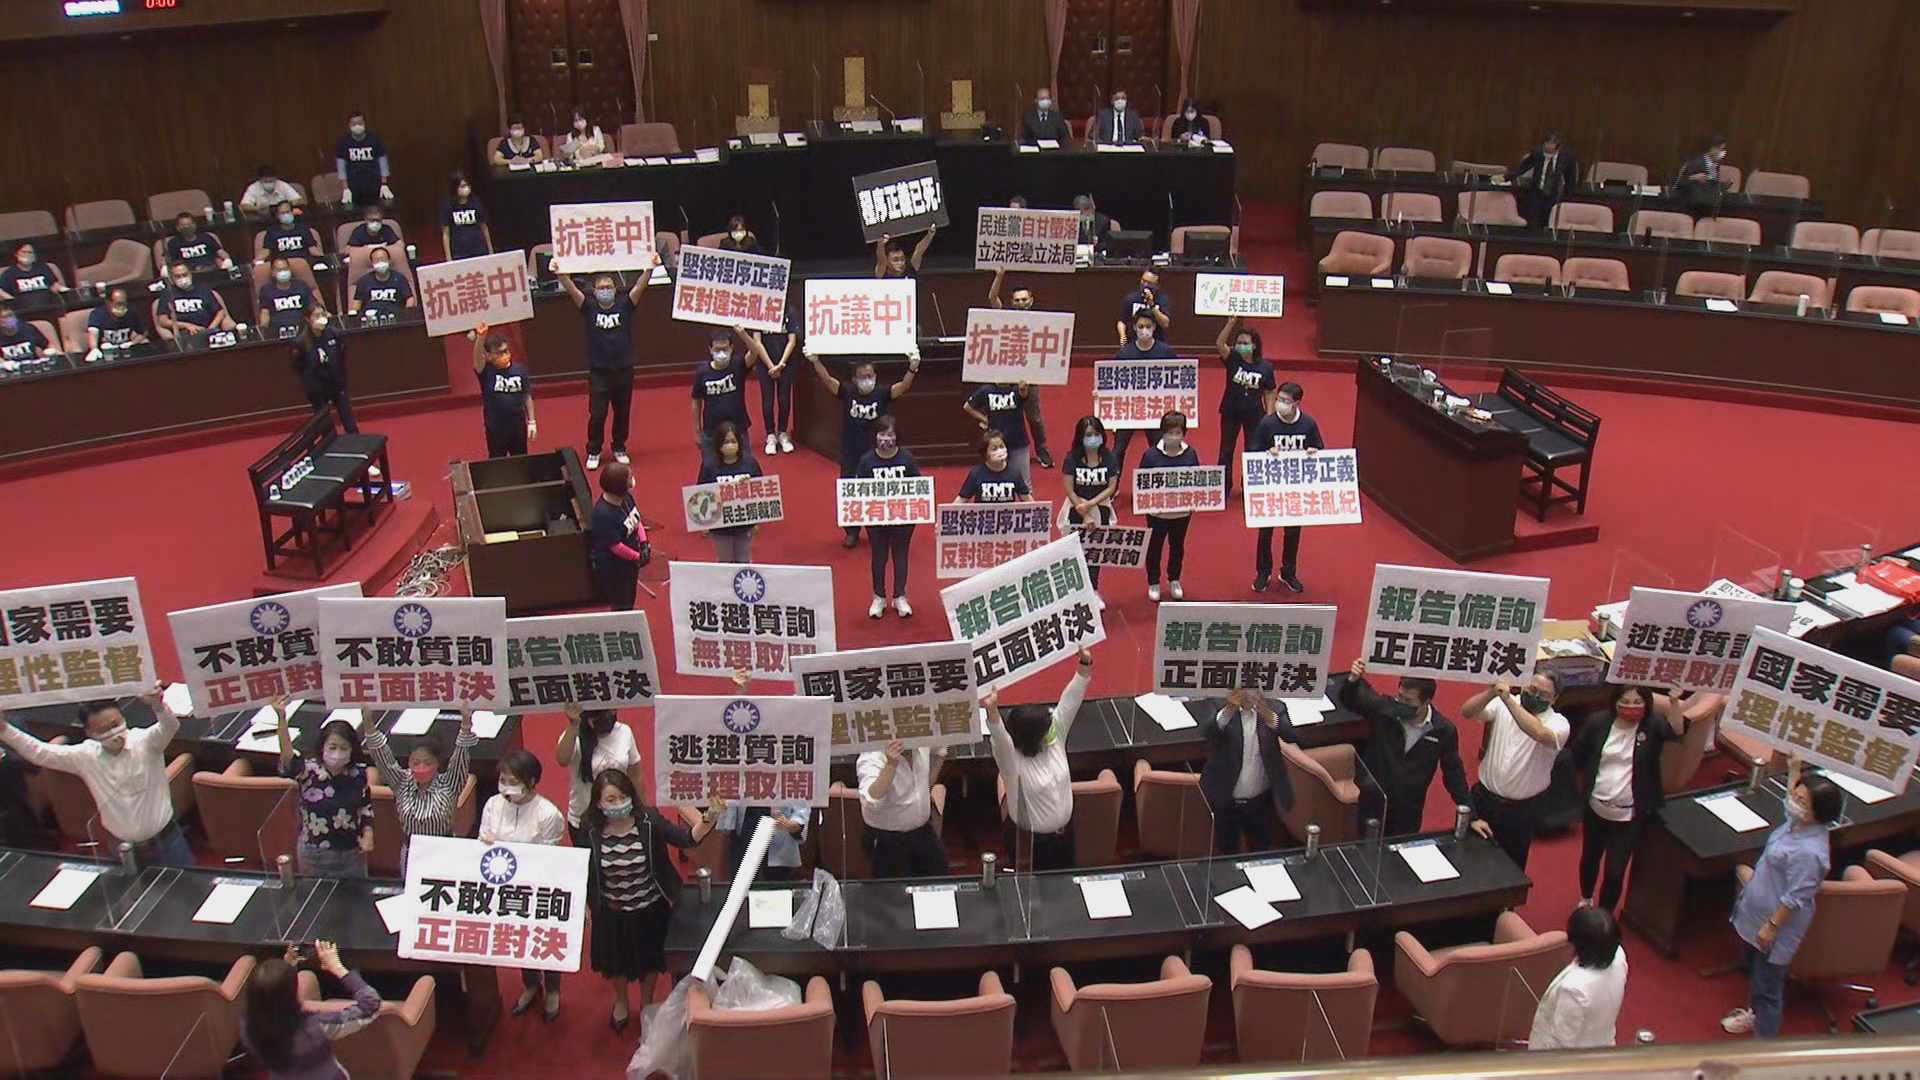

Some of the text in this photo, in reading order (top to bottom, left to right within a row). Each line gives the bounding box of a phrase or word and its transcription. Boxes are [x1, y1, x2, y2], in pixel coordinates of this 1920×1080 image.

[555, 215, 652, 257] 抗議中!
[977, 241, 1076, 266] 立法院變立法局
[680, 252, 787, 291] 堅持程序正義
[424, 265, 528, 320] 抗議中!
[677, 284, 783, 323] 反對違法亂紀
[809, 294, 912, 336] 抗議中!
[967, 323, 1071, 368] 抗議中!
[1097, 365, 1196, 390] 堅持程序正義
[1100, 395, 1196, 420] 反對違法亂紀
[1274, 434, 1306, 449] KMT
[872, 466, 906, 479] KMT
[1076, 467, 1107, 482] KMT
[1137, 470, 1222, 490] 程序違法違憲
[1247, 455, 1355, 486] 堅持程序正義
[720, 479, 779, 503] 破壞民主
[842, 480, 930, 498] 沒有程序正義
[981, 483, 1015, 498] KMT
[1137, 490, 1222, 510] 破壞憲政秩序
[1249, 490, 1358, 518] 反對違法亂紀
[842, 499, 931, 523] 沒有質詢
[941, 507, 1049, 536] 堅持程序正義
[941, 539, 1047, 569] 反對違法
[1086, 547, 1141, 566] 有質詢
[955, 557, 1088, 639] 報告備詢
[1377, 585, 1537, 634] 報告備詢
[0, 596, 134, 646] 家需要
[689, 601, 816, 638] 逃避質詢
[194, 627, 319, 674] 不敢質
[335, 636, 494, 668] 不敢質詢
[974, 602, 1095, 685] 正面對決
[1163, 621, 1324, 655] 報告備詢
[1369, 630, 1527, 678] 正面對決
[204, 661, 322, 709] 正面對
[339, 671, 496, 703] 正面對決
[509, 669, 652, 707] 正面對決
[802, 658, 970, 703] 國家需要
[1160, 659, 1318, 693] 正面對決
[1747, 645, 1920, 737] 國家需要
[669, 734, 815, 765] 逃避質詢
[1732, 688, 1910, 781] 理性監督
[669, 770, 814, 800] 無理取鬧
[419, 877, 572, 922] 不敢質詢
[414, 916, 568, 961] 正面對決
